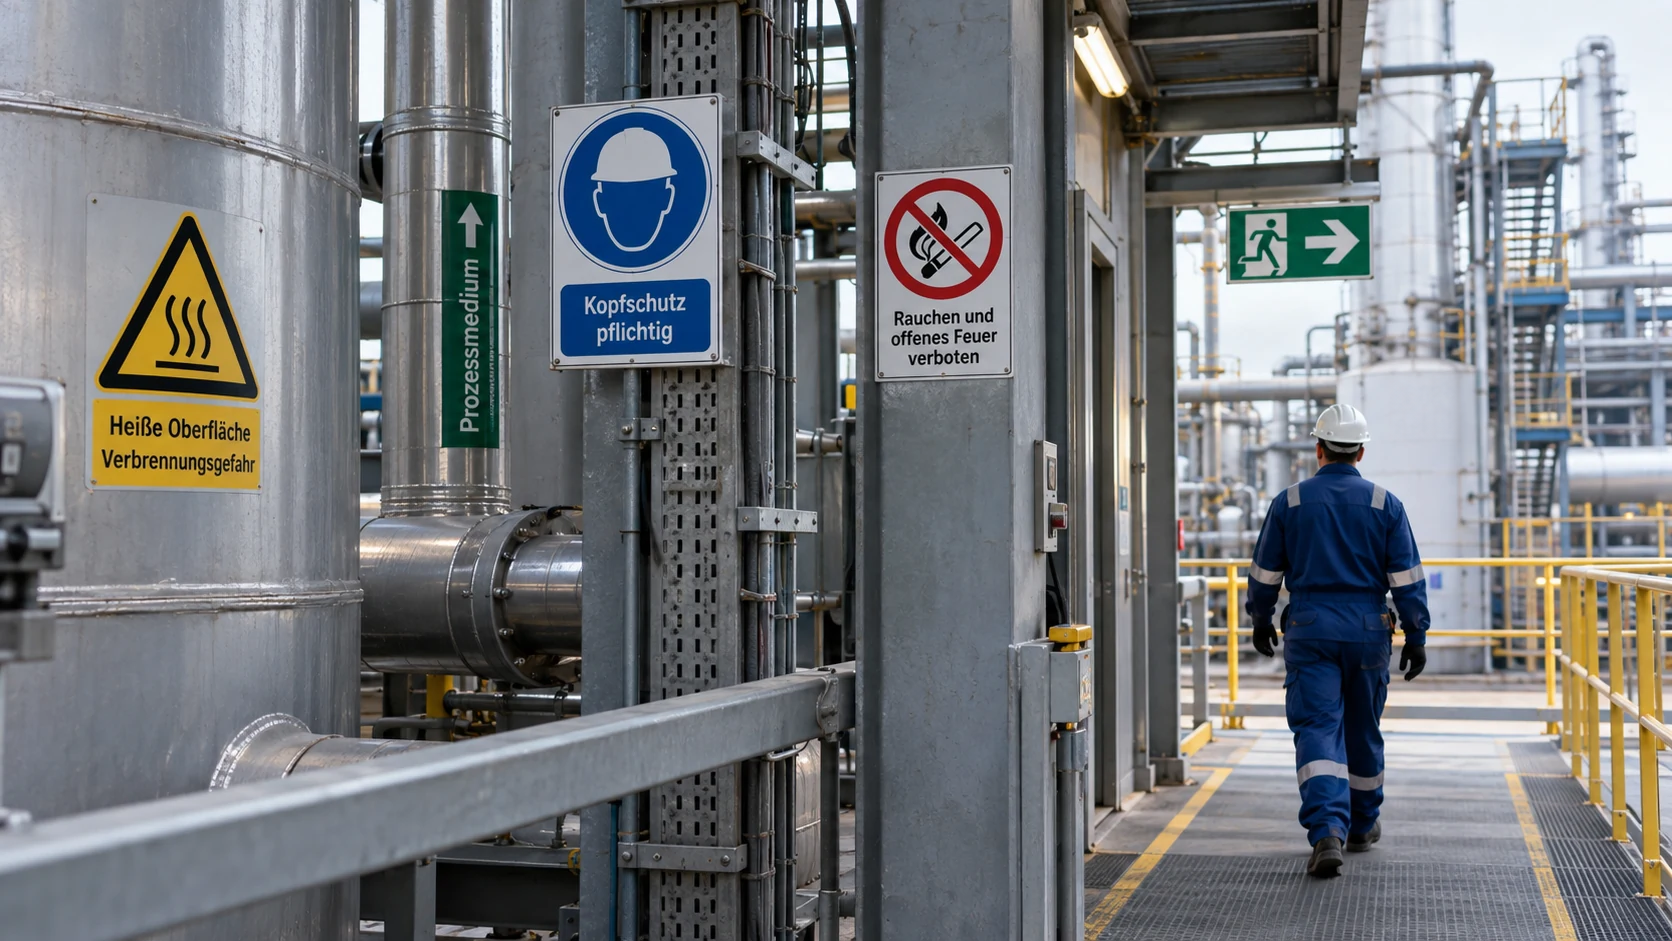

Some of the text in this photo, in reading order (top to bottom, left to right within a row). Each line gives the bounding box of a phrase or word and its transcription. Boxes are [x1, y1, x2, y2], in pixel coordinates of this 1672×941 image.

[584, 293, 686, 319] Kopfschutz
[894, 307, 994, 326] Rauchen und
[459, 258, 480, 432] Prozessmedium
[597, 320, 673, 347] pflichtig
[891, 328, 998, 346] offenes Feuer
[908, 349, 979, 366] verboten
[110, 415, 251, 442] Heiße Oberfläche
[101, 449, 255, 476] Verbrennungsgefahr
